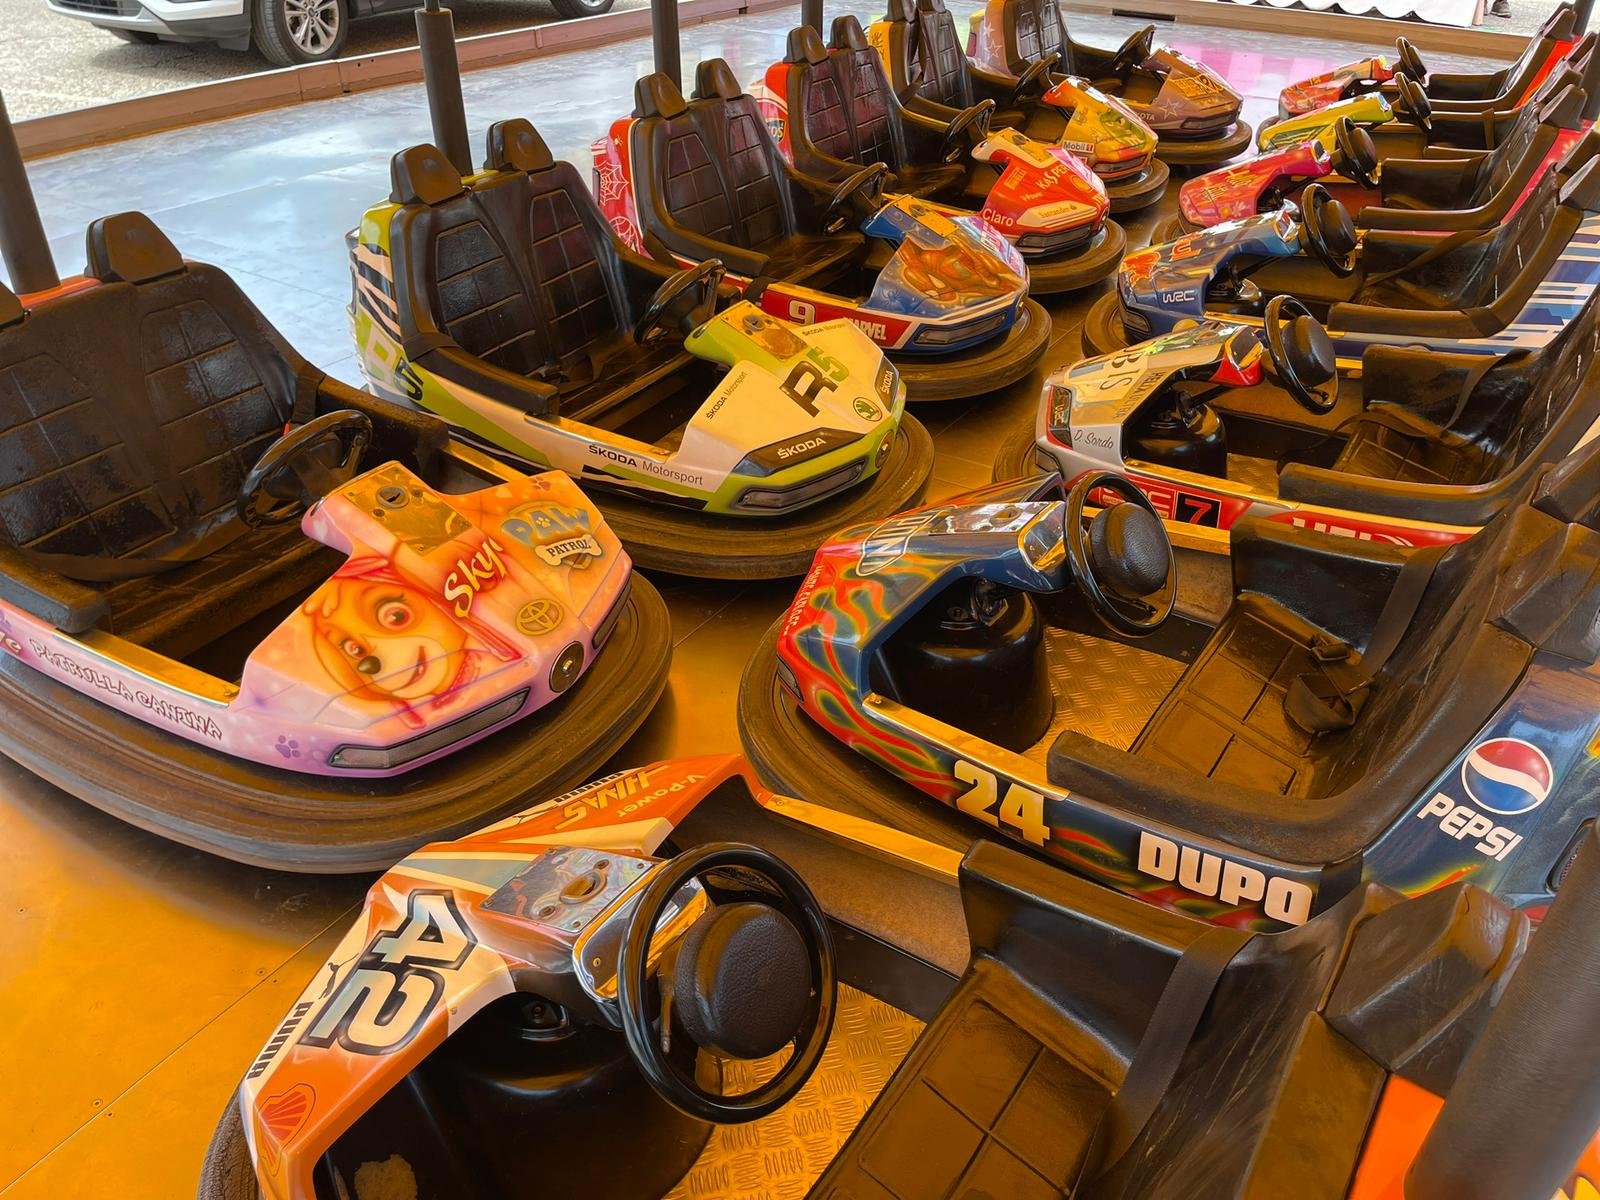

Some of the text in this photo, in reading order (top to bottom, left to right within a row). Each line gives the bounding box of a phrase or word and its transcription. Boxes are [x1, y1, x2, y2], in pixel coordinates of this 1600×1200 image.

[1064, 142, 1086, 151] Mobil
[982, 208, 1014, 227] Claro
[788, 300, 816, 325] 9
[1162, 290, 1195, 304] WRC
[848, 315, 888, 341] ARVEL
[706, 371, 748, 420] ŠKODA Motorsport
[779, 346, 850, 418] R5
[777, 437, 826, 460] ŠKODA
[1084, 432, 1114, 449] Sordo
[588, 443, 703, 485] ŠKODA Motorsport
[501, 508, 592, 549] PAW
[1184, 499, 1212, 526] 7
[546, 537, 592, 558] PATROL
[136, 690, 223, 740] CANINA
[616, 774, 706, 818] V-Power
[954, 758, 1050, 848] 24
[1416, 792, 1524, 862] PEPSI
[1138, 830, 1313, 926] DUPO
[296, 889, 479, 1057] 42
